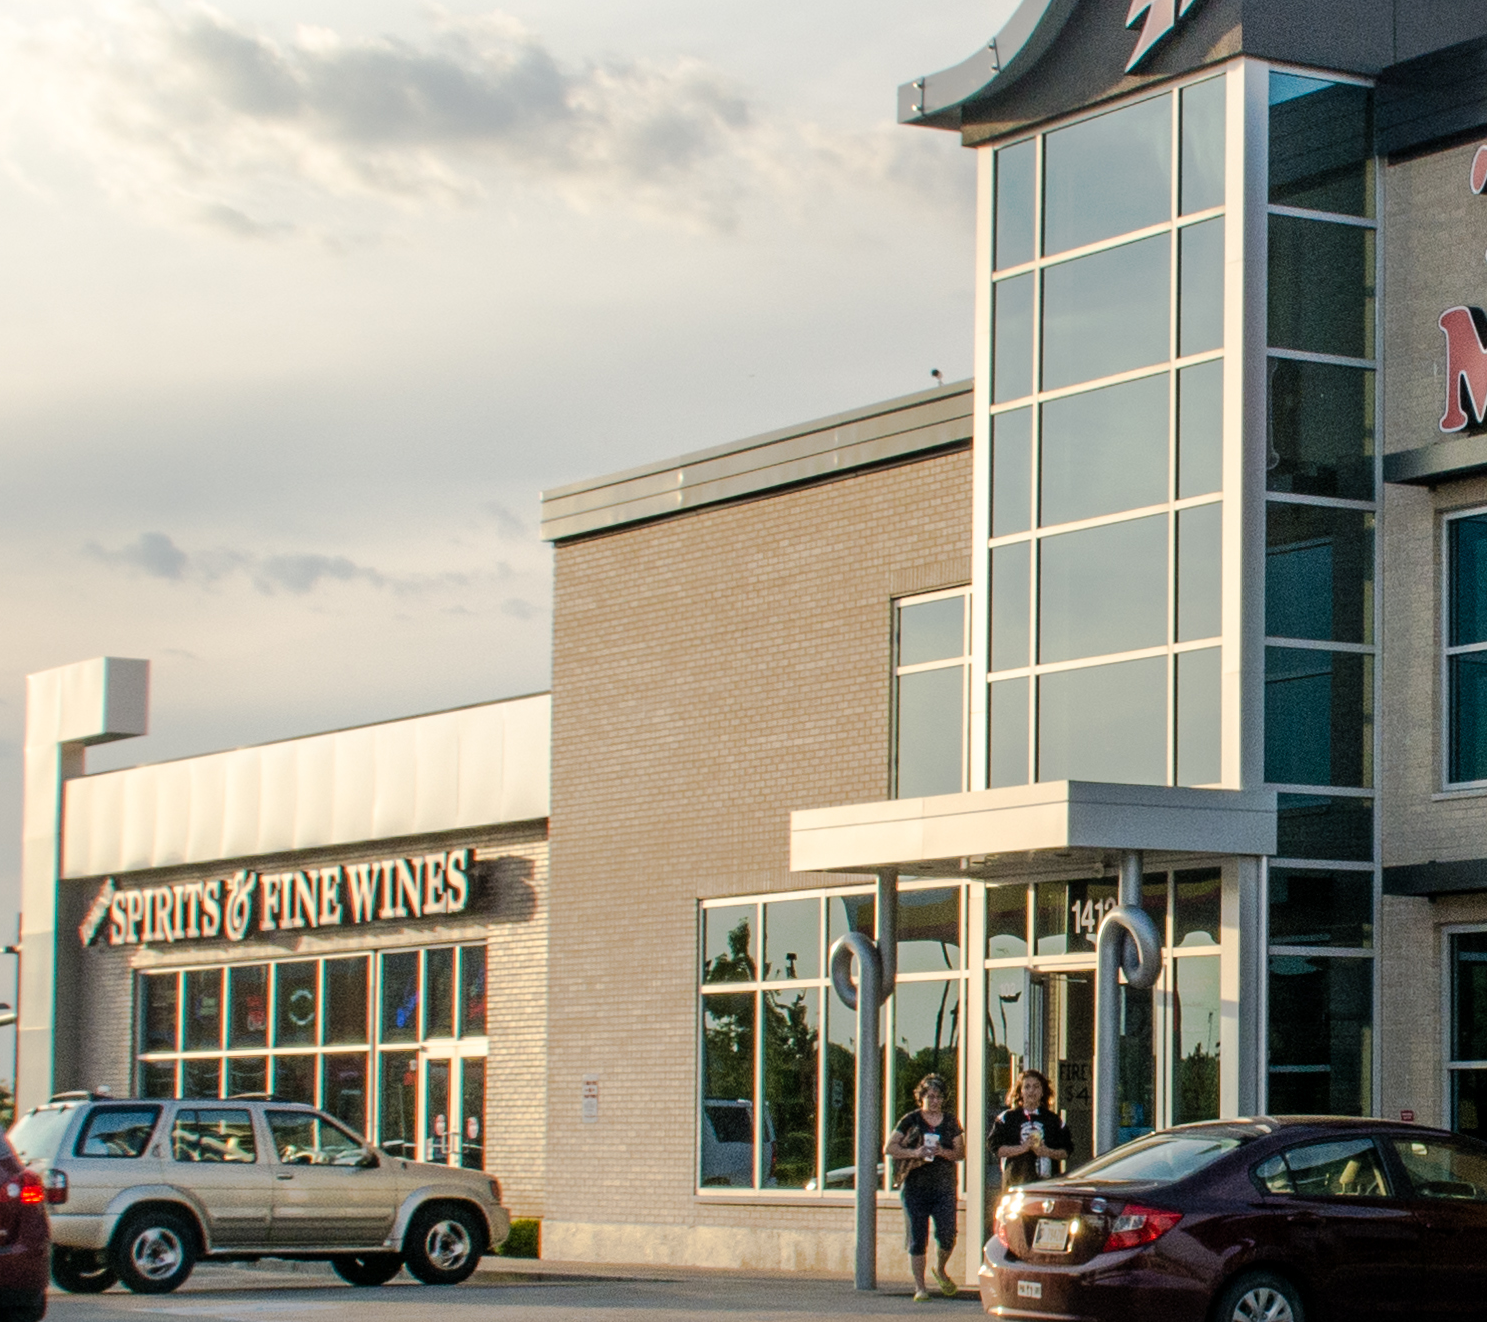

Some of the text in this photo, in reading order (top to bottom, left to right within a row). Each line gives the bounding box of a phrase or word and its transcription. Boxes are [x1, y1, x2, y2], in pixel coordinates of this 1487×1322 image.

[110, 880, 222, 946] SPIRITS
[259, 865, 344, 932] FINE
[346, 849, 470, 925] WINES
